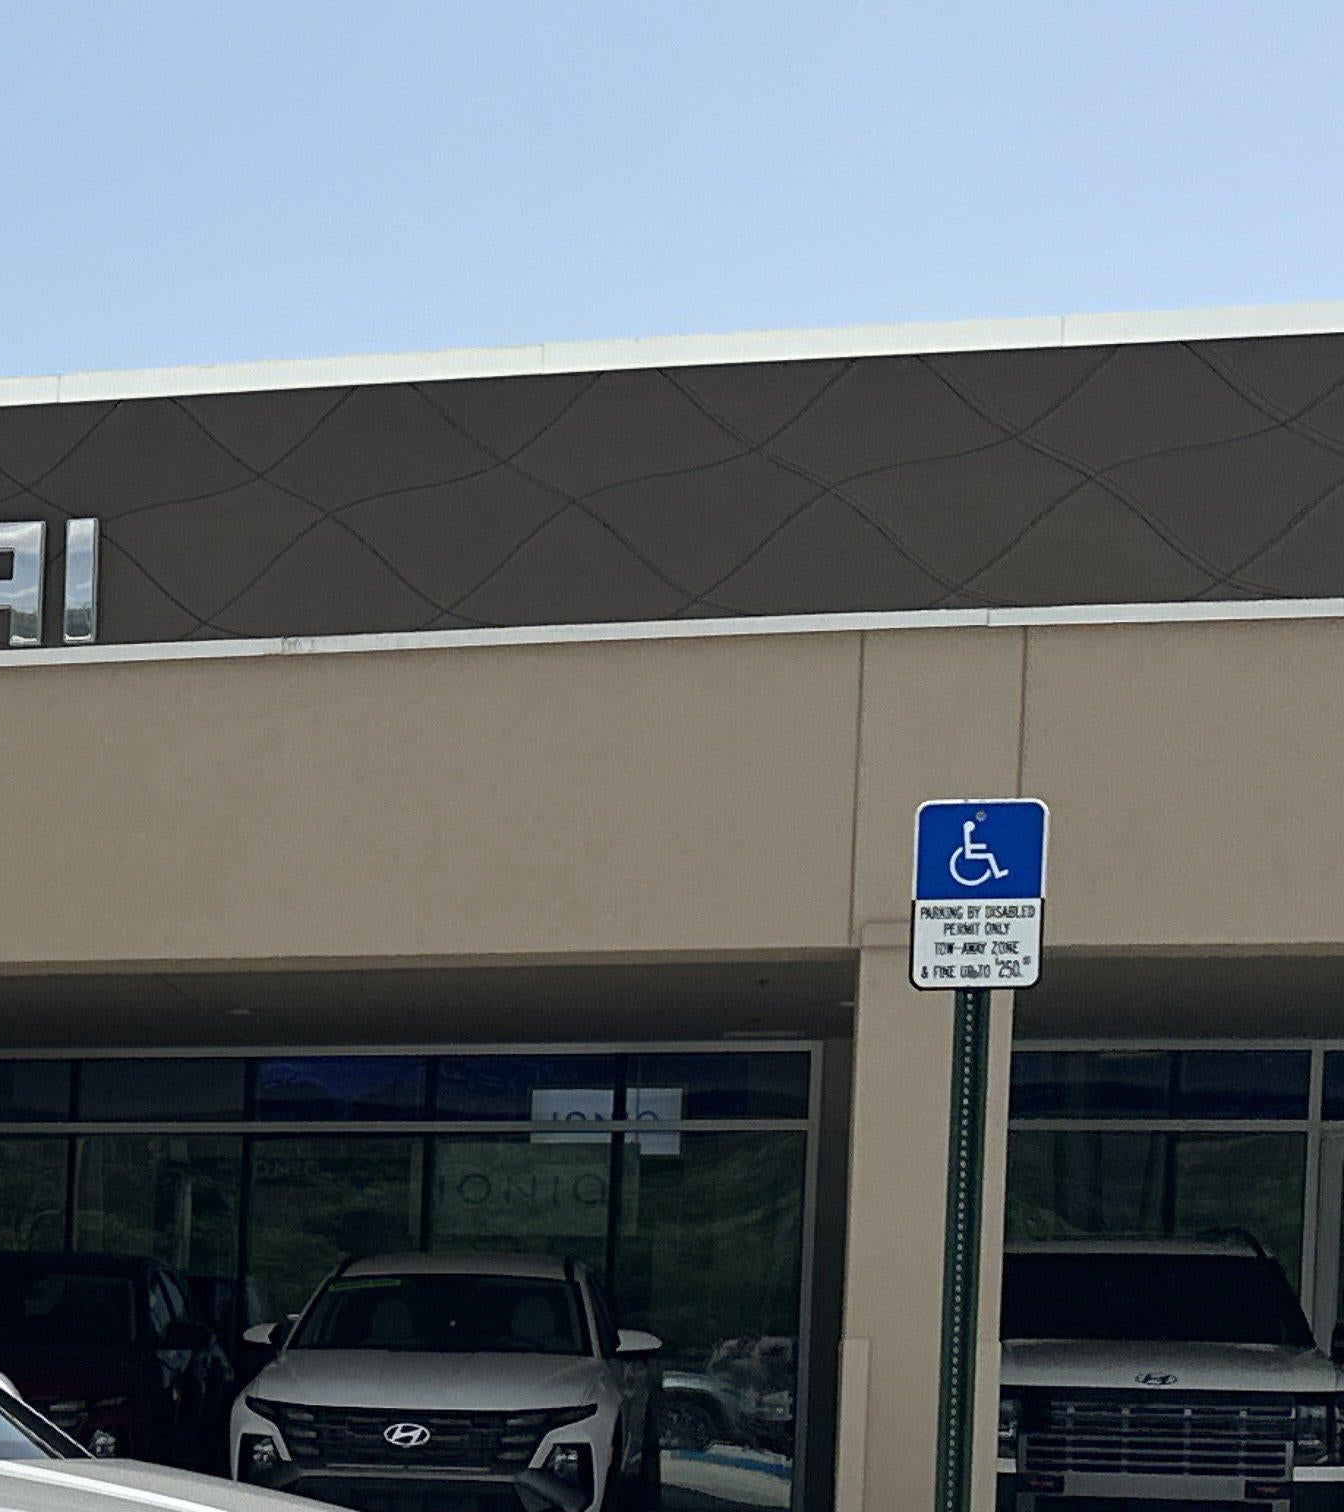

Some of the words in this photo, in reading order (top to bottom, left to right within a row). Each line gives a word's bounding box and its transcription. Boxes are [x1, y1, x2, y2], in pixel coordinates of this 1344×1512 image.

[920, 906, 963, 919] PARKING
[967, 906, 981, 919] BY
[985, 905, 1035, 919] DISABLED
[943, 922, 981, 936] PERMIT
[984, 922, 1011, 935] ONLY
[934, 942, 987, 956] TOW-AWAY
[991, 941, 1020, 955] ZONE
[921, 966, 929, 979] &
[933, 965, 956, 979] FINE
